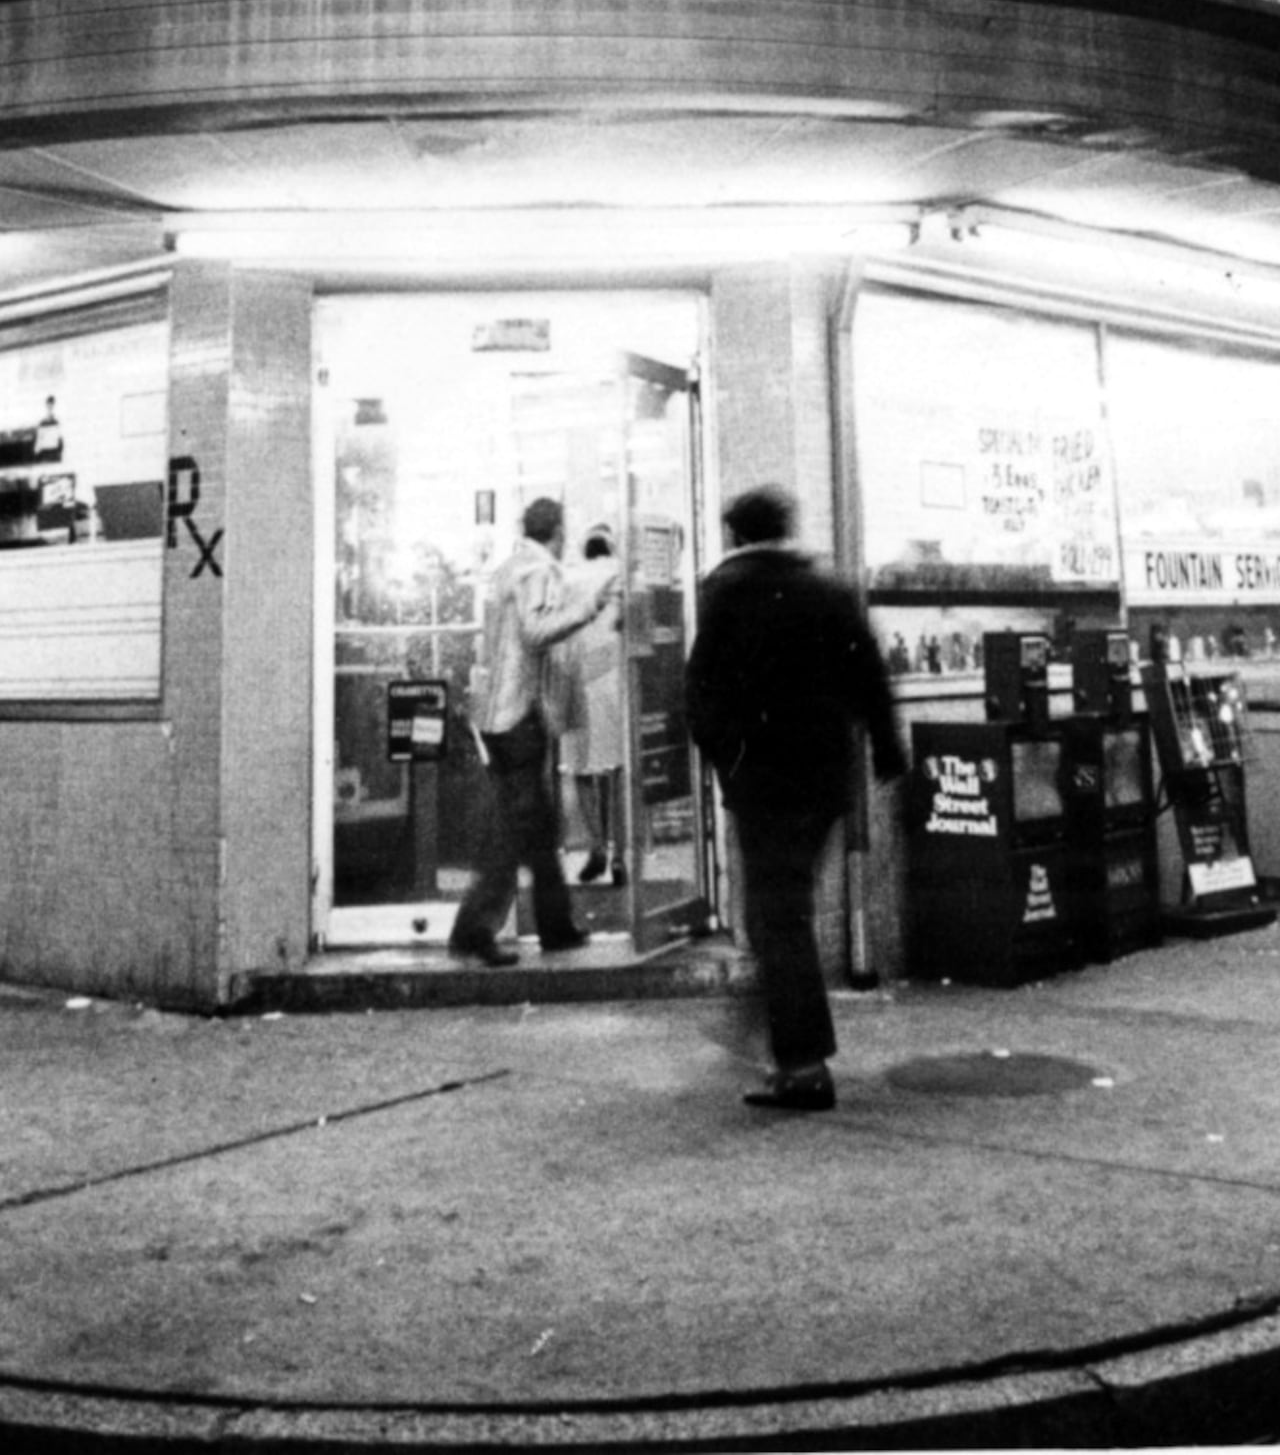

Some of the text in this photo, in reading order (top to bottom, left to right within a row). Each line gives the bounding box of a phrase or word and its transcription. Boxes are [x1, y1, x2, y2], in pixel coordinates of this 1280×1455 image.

[1145, 551, 1222, 589] FOUNTAIN
[940, 755, 977, 776] The
[939, 774, 980, 796] Wall
[933, 793, 989, 815] Street
[925, 811, 998, 837] Journal
